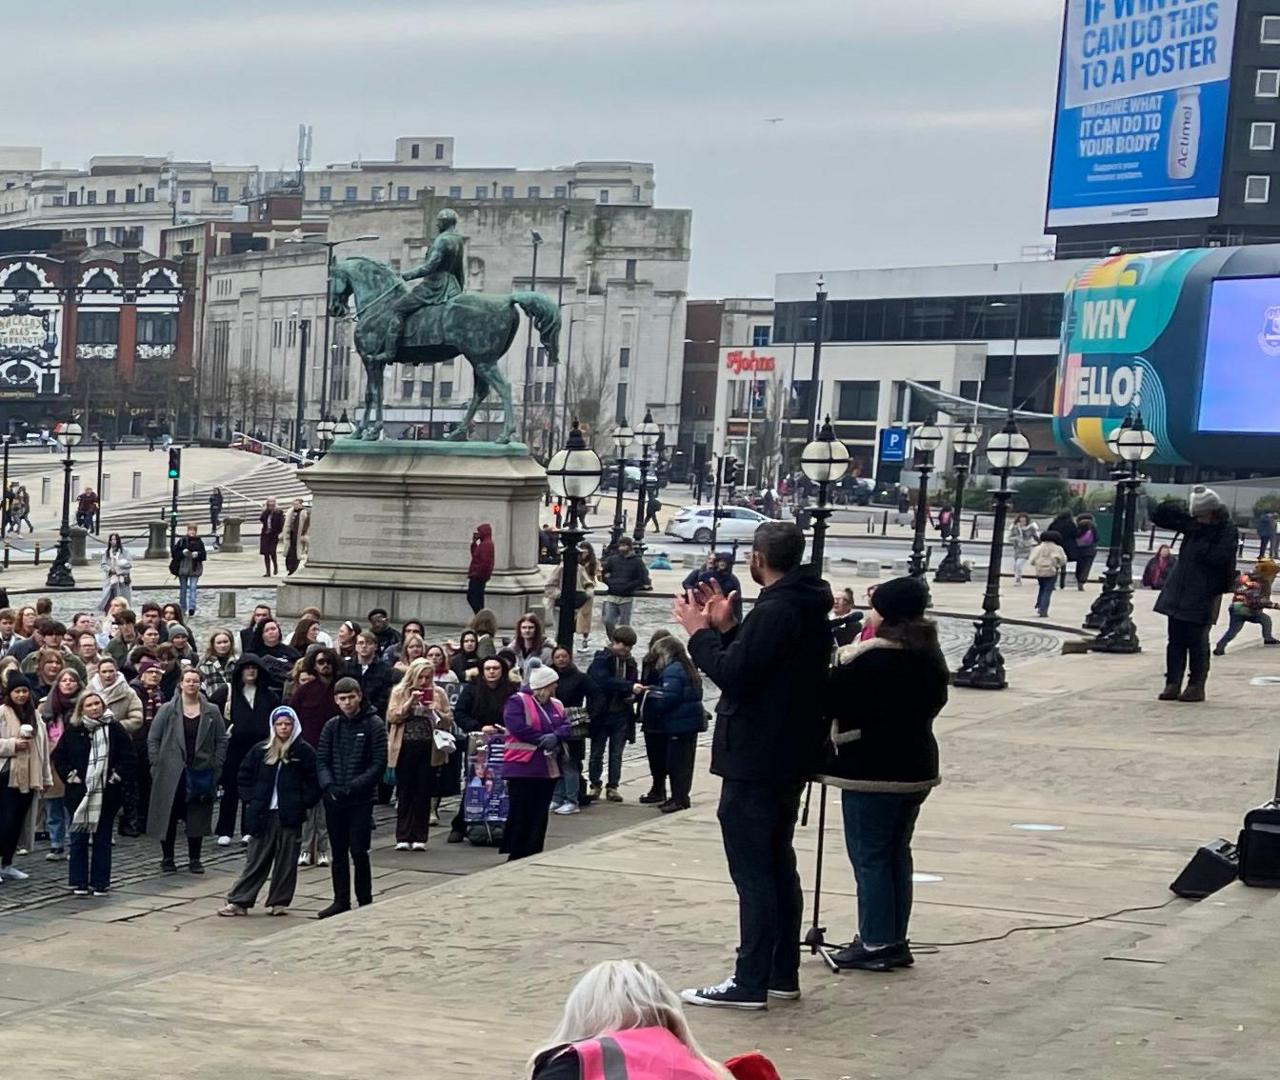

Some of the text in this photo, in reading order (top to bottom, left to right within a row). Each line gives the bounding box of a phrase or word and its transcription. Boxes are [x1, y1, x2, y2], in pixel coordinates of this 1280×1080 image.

[1083, 22, 1126, 58] CAN
[1131, 15, 1162, 48] DO
[1168, 1, 1218, 39] THIS
[1081, 36, 1217, 91] TO A POSTER
[1129, 95, 1163, 113] WHAT
[1079, 132, 1160, 158] YOUR BODY?
[1080, 113, 1162, 138] IT CAN DO TO
[1177, 106, 1193, 168] Actimel
[1081, 299, 1136, 340] WHY
[1075, 366, 1144, 407] ELLO!
[890, 434, 899, 447] P
